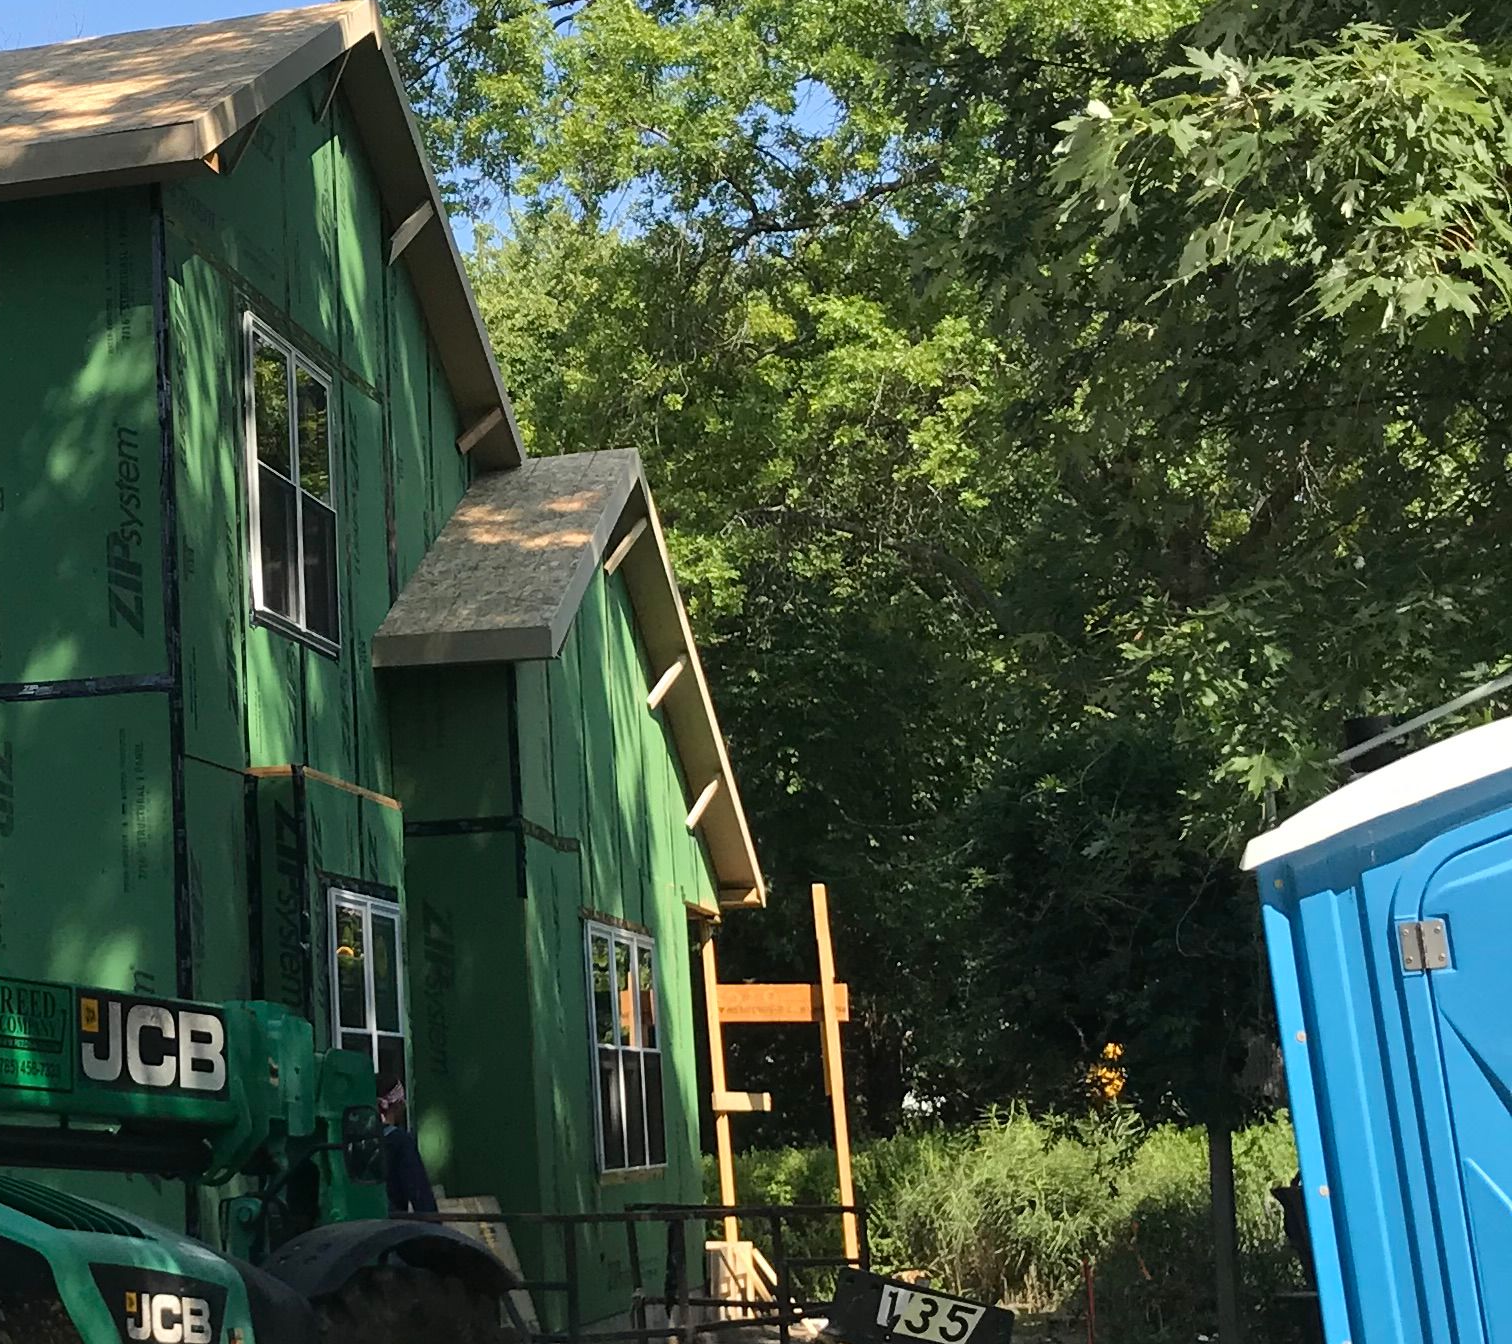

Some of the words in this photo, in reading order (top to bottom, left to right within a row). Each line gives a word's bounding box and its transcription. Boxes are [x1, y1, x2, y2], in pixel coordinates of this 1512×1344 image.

[0, 984, 56, 1018] REED
[82, 1001, 226, 1091] JCB
[127, 1293, 212, 1344] JCB
